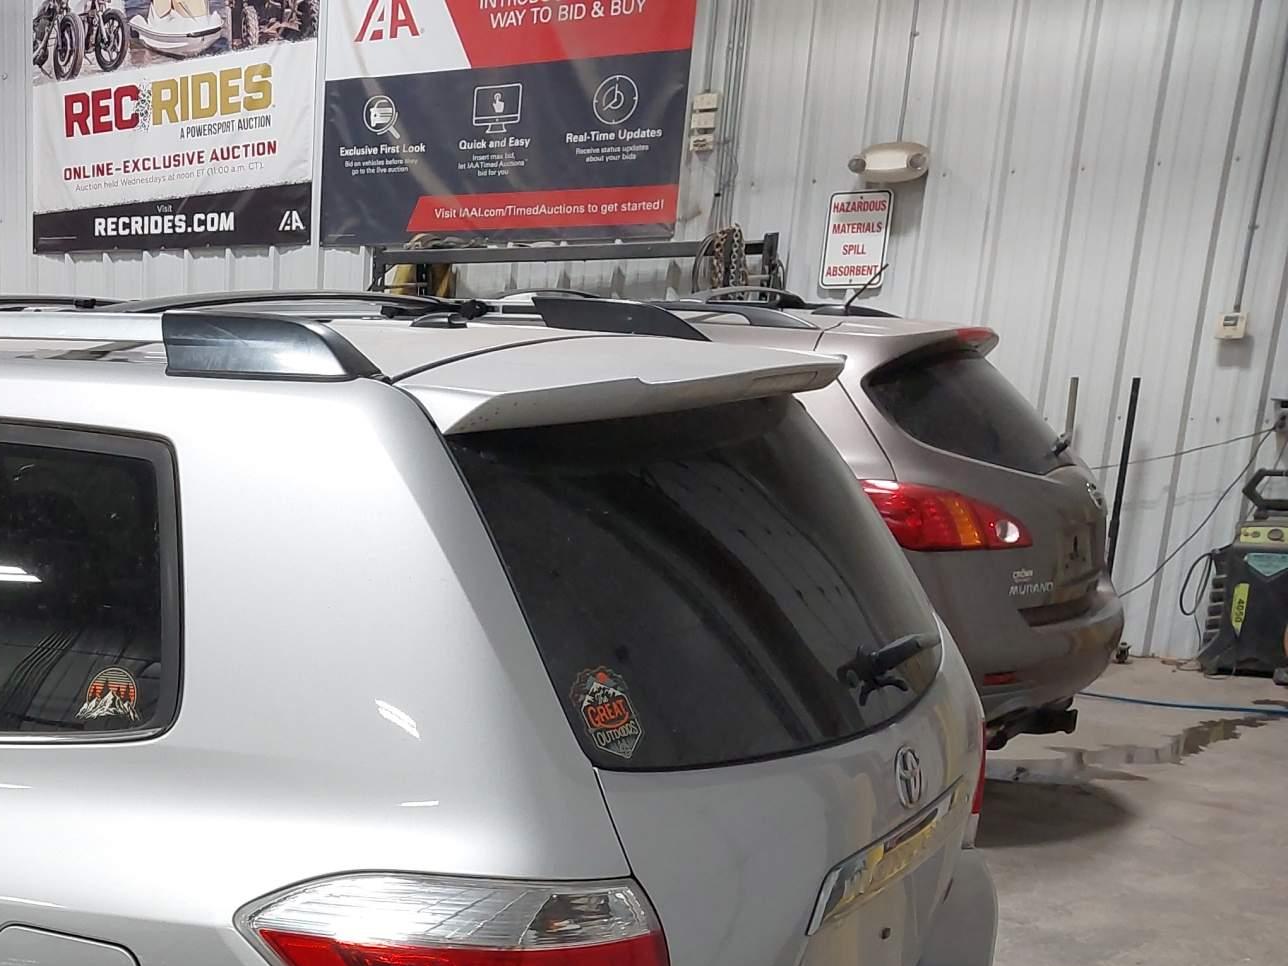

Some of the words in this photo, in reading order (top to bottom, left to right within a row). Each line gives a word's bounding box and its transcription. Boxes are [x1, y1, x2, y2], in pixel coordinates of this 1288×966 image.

[490, 10, 526, 28] WAY
[530, 6, 552, 24] TO
[558, 3, 586, 21] BID
[591, 1, 604, 17] &
[610, 0, 646, 16] BUY
[64, 85, 140, 138] REC
[151, 62, 273, 126] RIDES
[180, 128, 185, 140] A
[186, 118, 235, 139] POWERSPORT
[237, 114, 271, 135] AUCTION
[458, 138, 487, 150] Quick
[488, 137, 507, 148] and
[508, 136, 531, 148] Easy
[566, 130, 615, 143] Real-Time
[618, 128, 662, 141] Updates
[339, 145, 378, 157] Exclusive
[379, 143, 400, 154] First
[402, 142, 426, 153] Look
[575, 147, 600, 155] Receive
[622, 144, 649, 152] updates
[64, 150, 205, 181] ONLINE-EXCLUSIVE
[210, 140, 277, 162] AUCTION
[344, 159, 354, 168] Bid
[388, 165, 409, 173] auction
[75, 182, 102, 192] Auction
[104, 180, 119, 188] held
[120, 175, 166, 187] Wednesdays
[168, 173, 175, 181] at
[176, 172, 195, 180] noon
[197, 168, 205, 177] ET
[156, 204, 173, 213] Visit
[434, 207, 457, 219] Visit
[459, 203, 585, 219] IAAI.com/TimedAuctions
[587, 204, 598, 213] to
[600, 202, 618, 215] get
[620, 199, 665, 212] started!
[832, 199, 887, 213] HAZARDOUS
[94, 211, 235, 237] RECRIDES.COM
[832, 221, 883, 234] MATERIALS
[842, 244, 866, 255] SPILL
[825, 264, 879, 277] ABSORBENT
[1009, 582, 1053, 596] MURANO
[587, 697, 630, 729] GREAT
[596, 719, 639, 747] OUTDOORS
